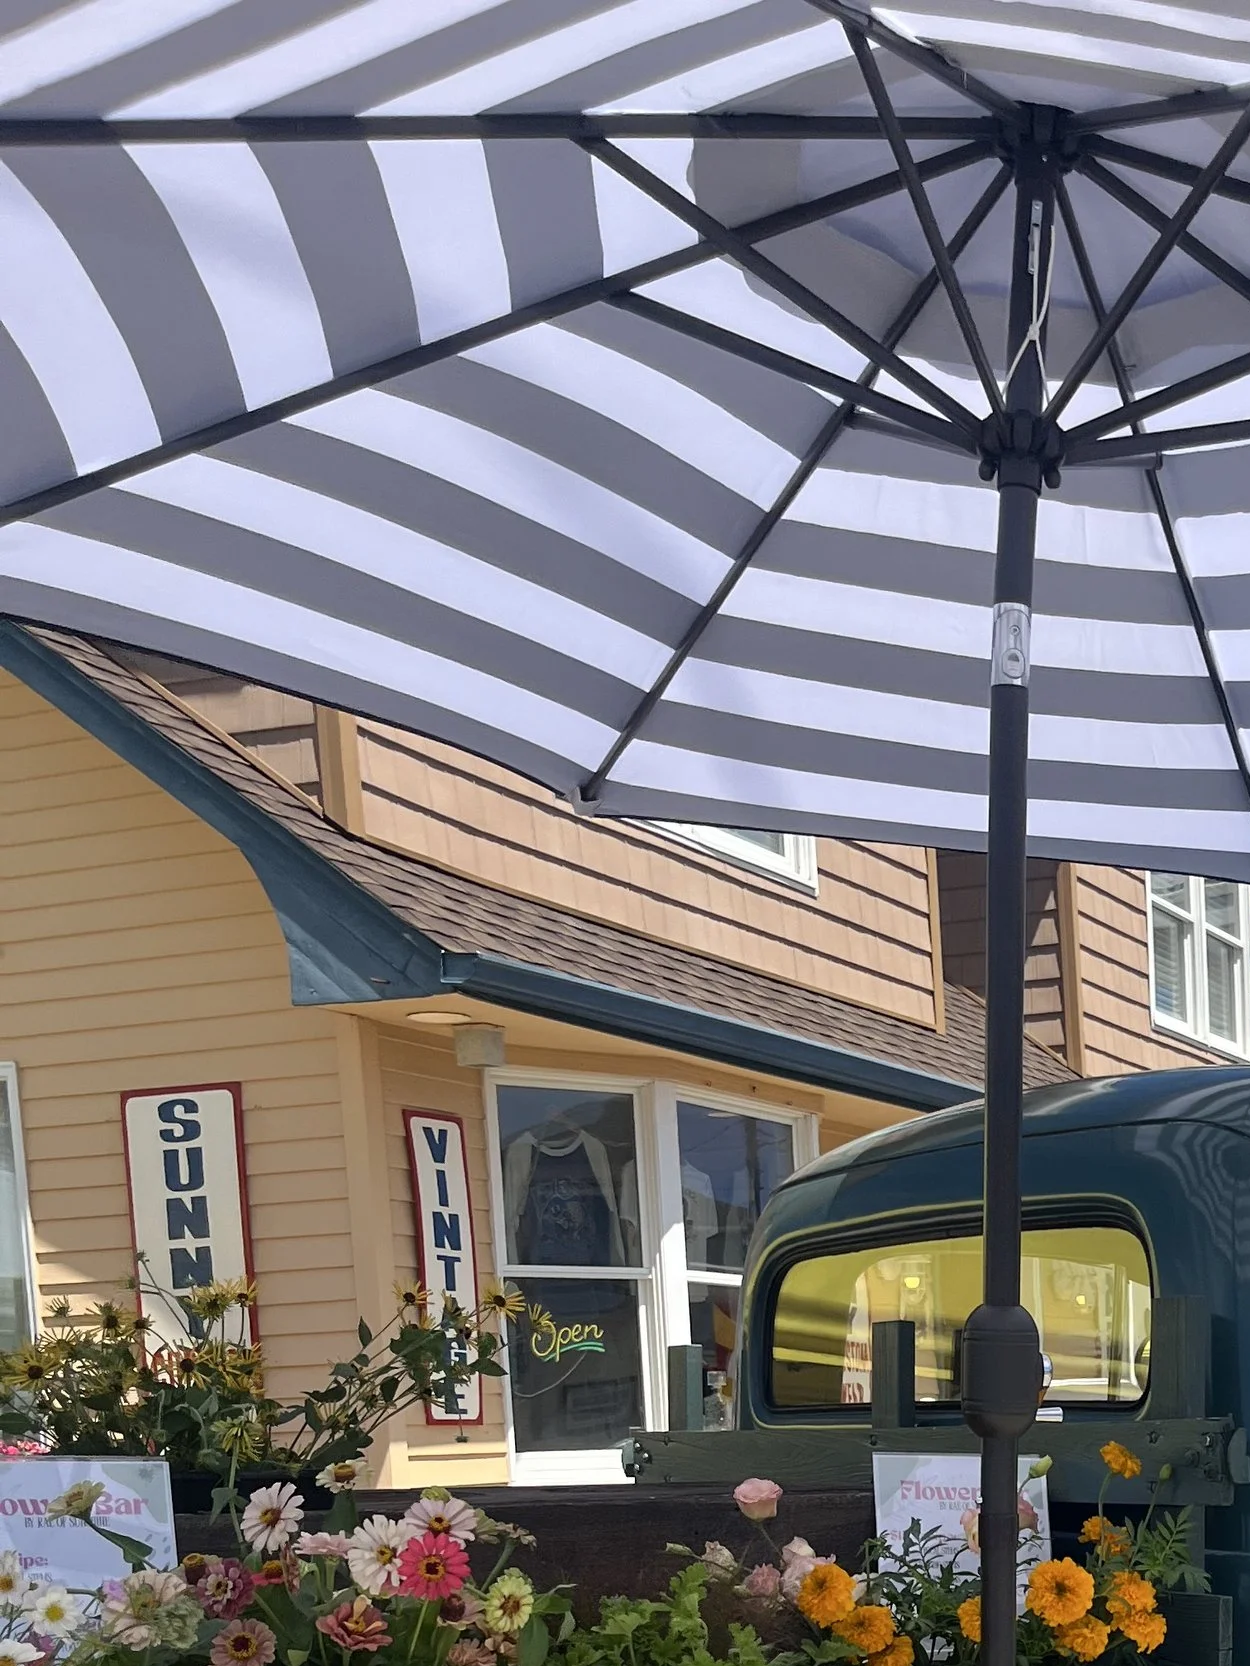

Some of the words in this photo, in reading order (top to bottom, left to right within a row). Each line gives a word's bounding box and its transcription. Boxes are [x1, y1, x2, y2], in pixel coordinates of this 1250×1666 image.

[532, 1322, 605, 1362] Open
[95, 1491, 149, 1515] Bar
[24, 1517, 34, 1528] BY
